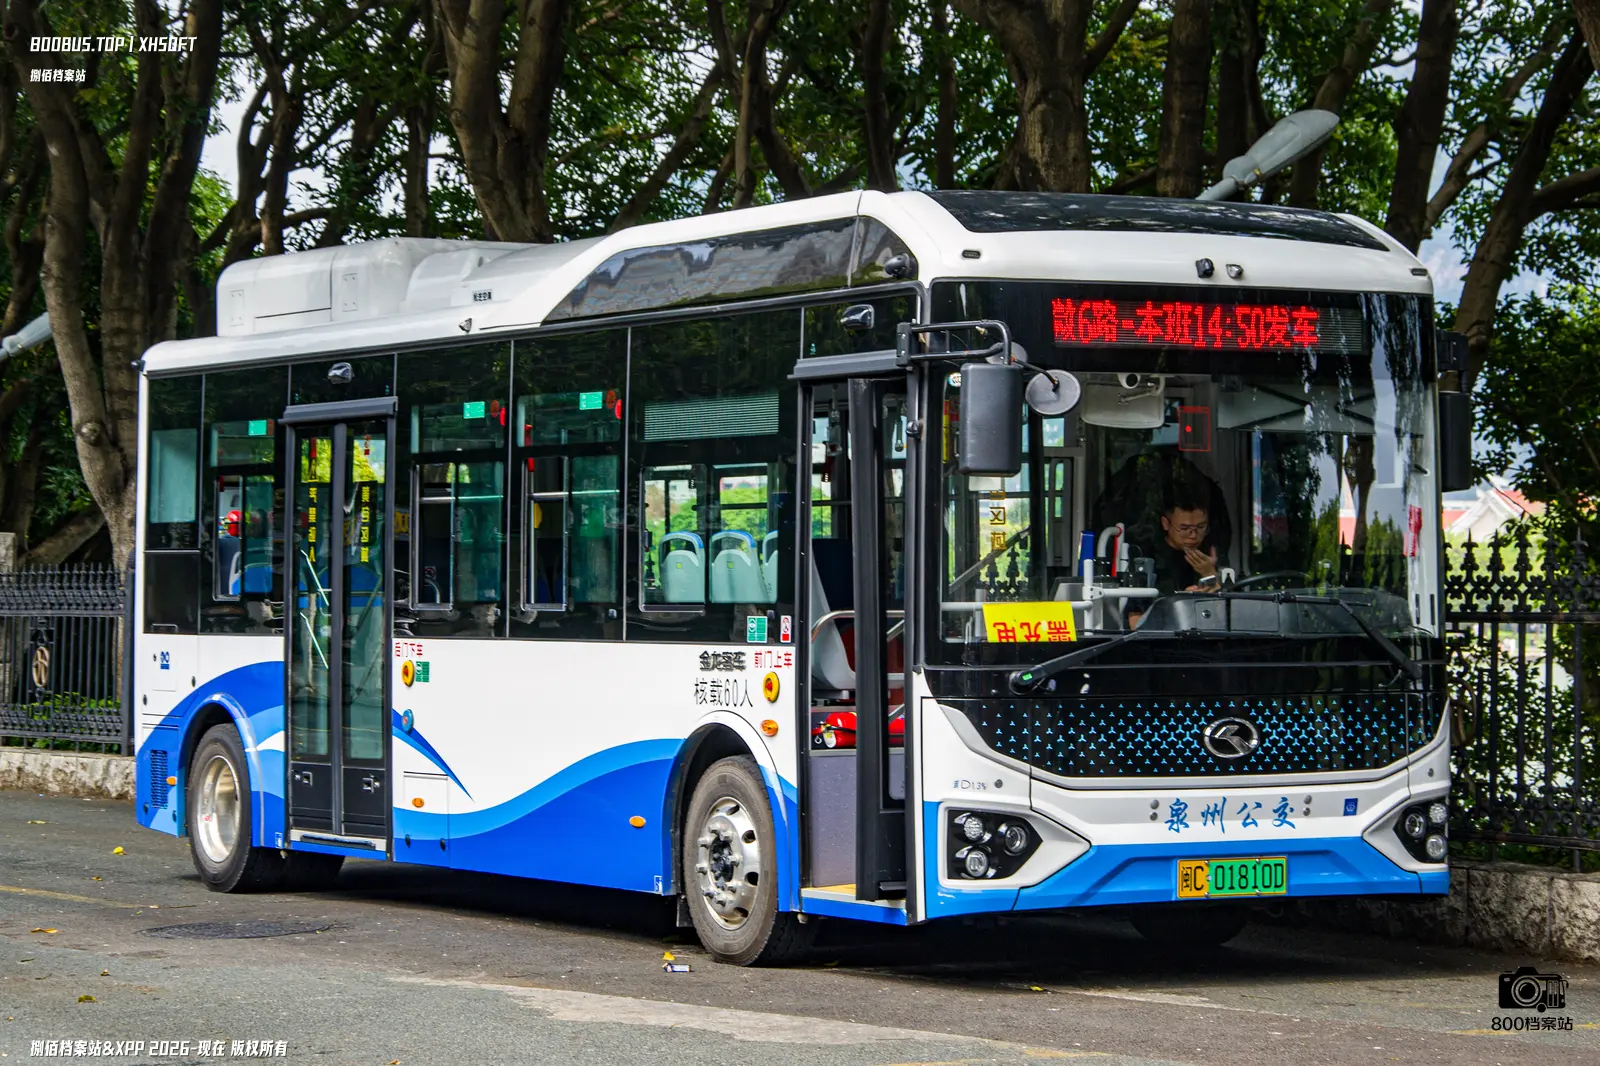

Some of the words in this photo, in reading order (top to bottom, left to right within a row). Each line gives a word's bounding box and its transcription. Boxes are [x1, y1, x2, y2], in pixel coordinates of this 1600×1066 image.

[395, 641, 423, 658] 后门下车
[699, 650, 746, 672] 金龙客车
[754, 650, 793, 669] 前门上车
[694, 678, 754, 707] 核载60人
[1164, 796, 1297, 834] 泉州公交
[1214, 863, 1285, 891] 01810D
